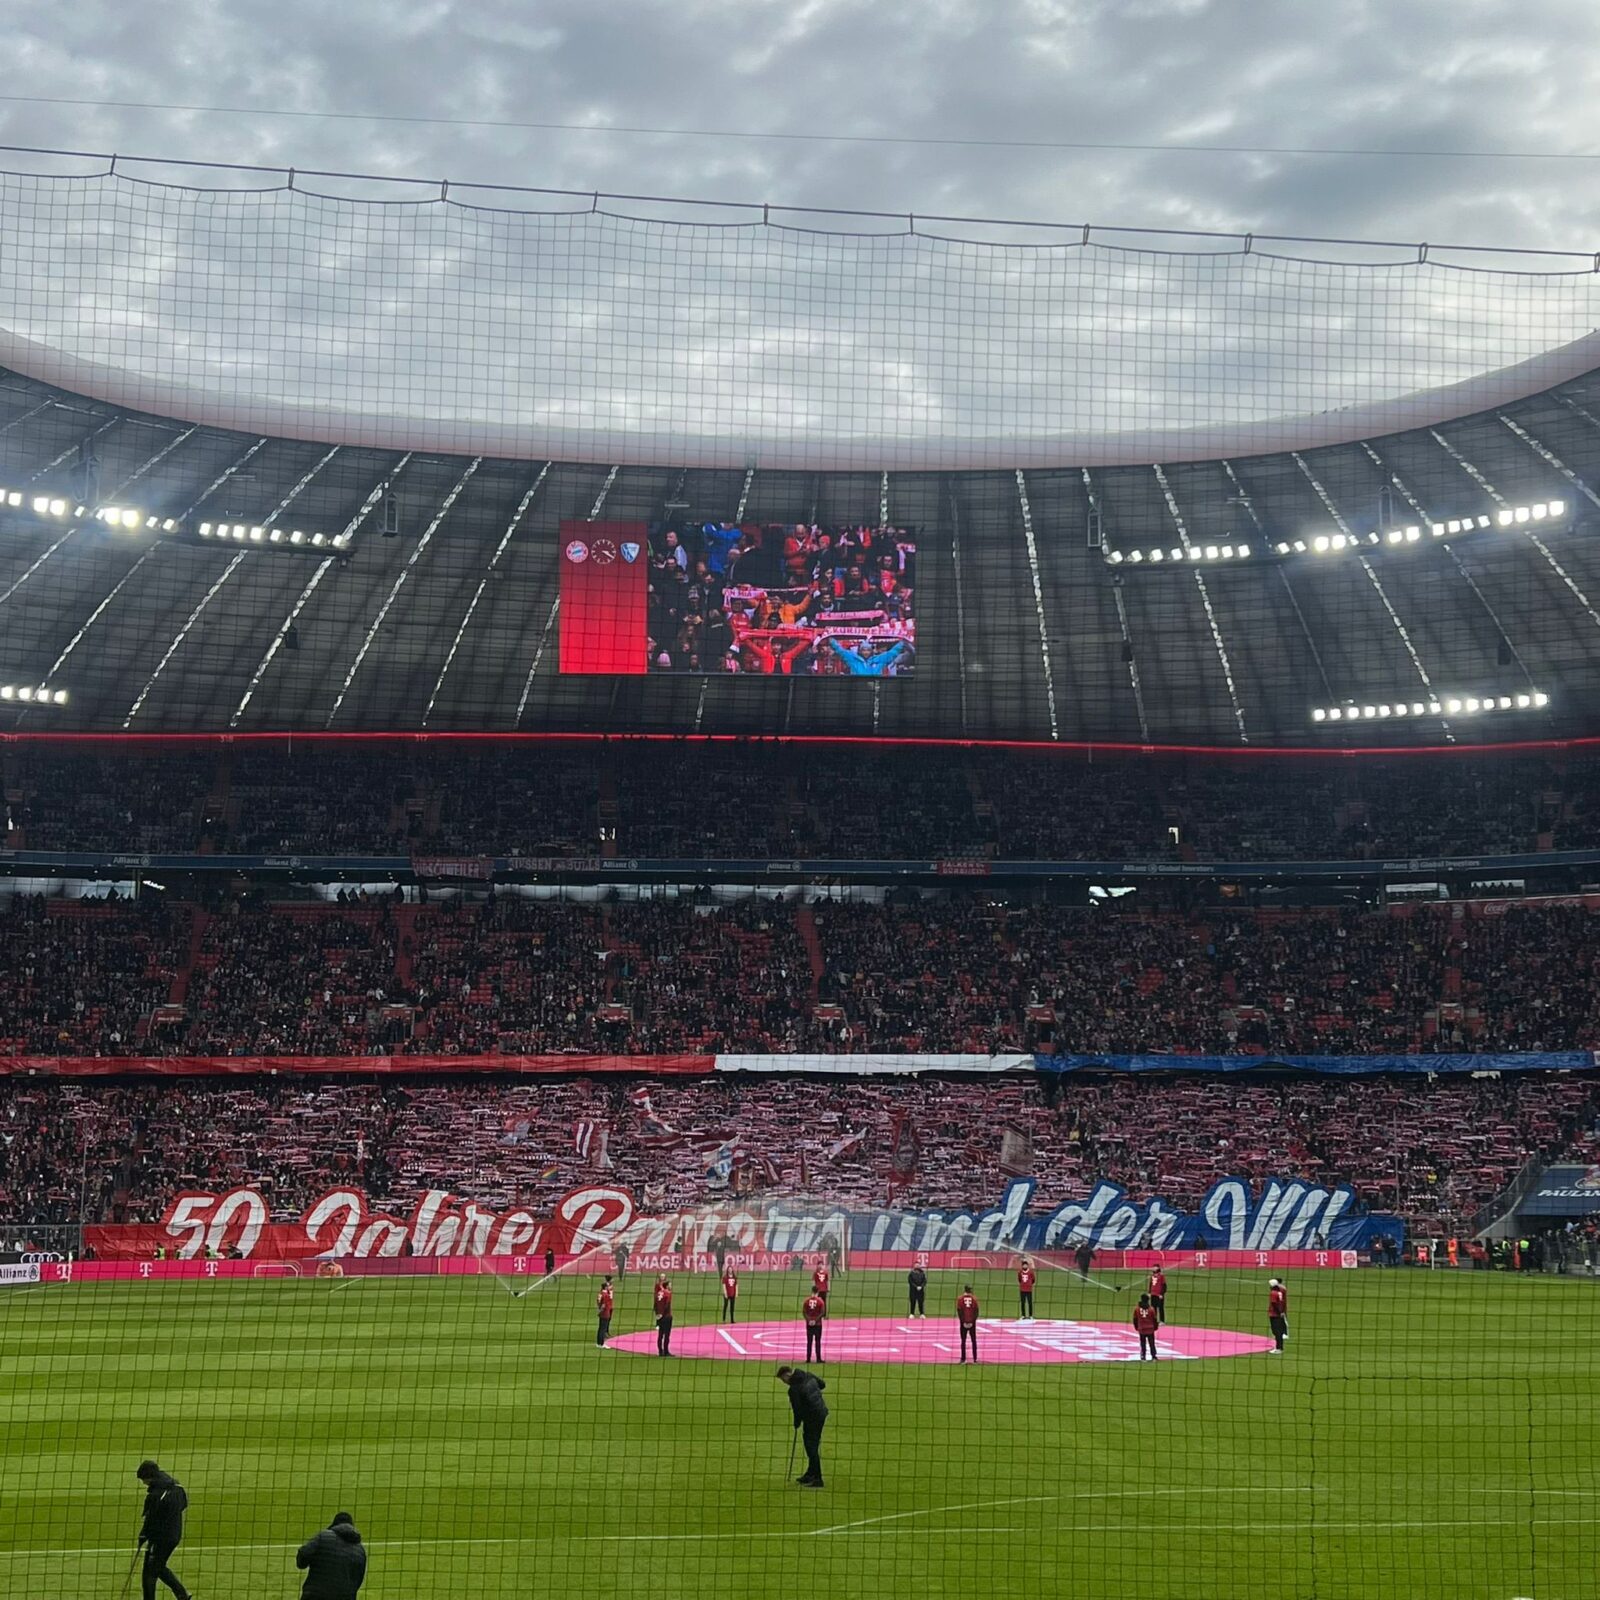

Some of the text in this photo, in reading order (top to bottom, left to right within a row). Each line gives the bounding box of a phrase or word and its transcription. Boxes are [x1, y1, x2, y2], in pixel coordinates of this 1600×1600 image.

[113, 856, 140, 865] Allianz
[263, 858, 290, 866] Allianz
[1382, 860, 1479, 870] Allianz Global Investors
[1122, 864, 1214, 873] Allianz Global Investors
[166, 1187, 266, 1259] 50
[869, 1182, 1031, 1251] und
[1045, 1185, 1185, 1251] der
[514, 1257, 526, 1271] T
[1196, 1252, 1207, 1266] T
[1256, 1252, 1267, 1266] T
[1316, 1252, 1327, 1266] T
[140, 1262, 152, 1277] T
[206, 1261, 218, 1276] T
